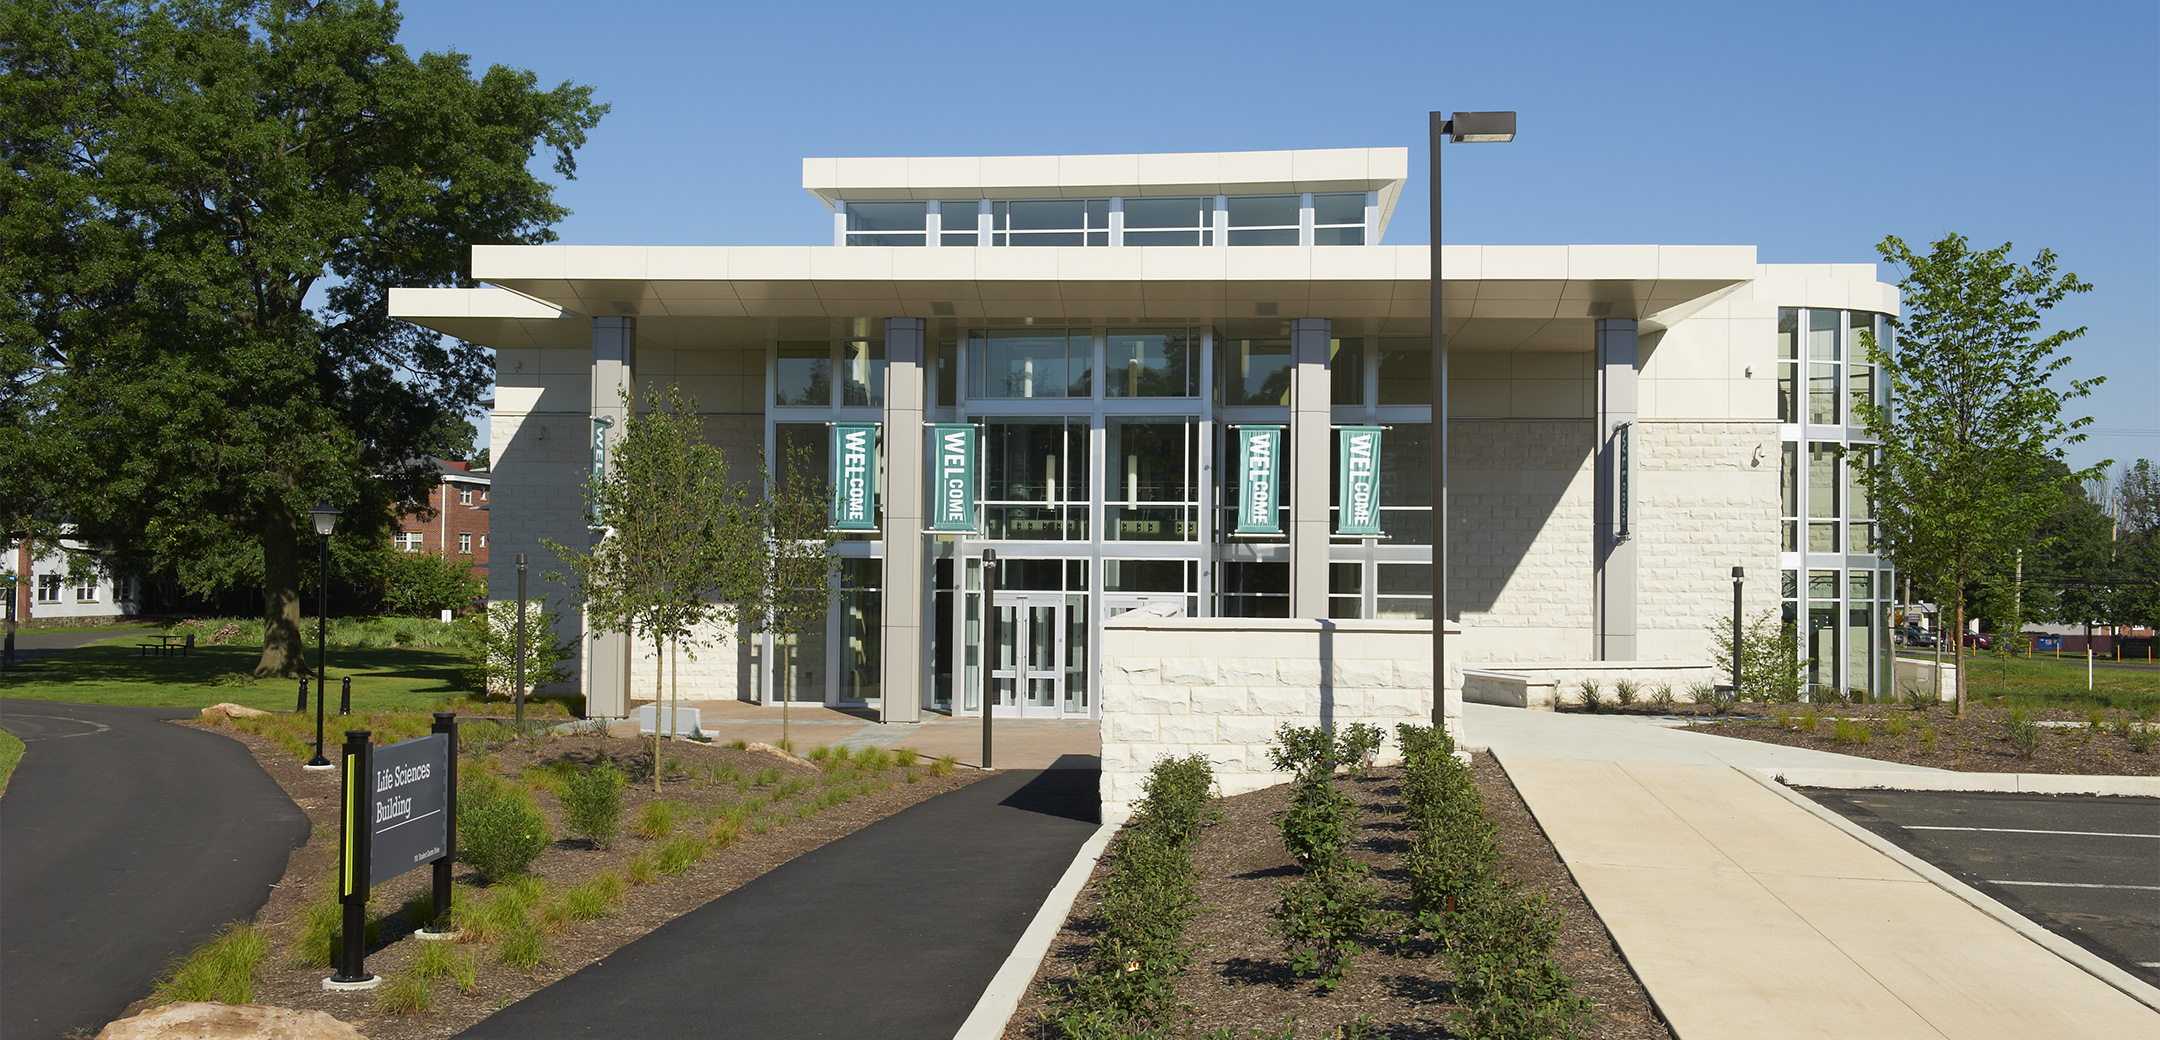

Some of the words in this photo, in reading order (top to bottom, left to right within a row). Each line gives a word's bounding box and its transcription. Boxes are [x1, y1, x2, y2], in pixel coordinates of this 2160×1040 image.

[845, 431, 866, 520] WELCOME
[944, 431, 965, 521] WELCOME
[1249, 433, 1271, 524] WELCOME
[1349, 434, 1371, 526] WELCOME
[376, 768, 394, 793] Life
[394, 763, 430, 787] Sciences
[376, 795, 412, 824] Building
